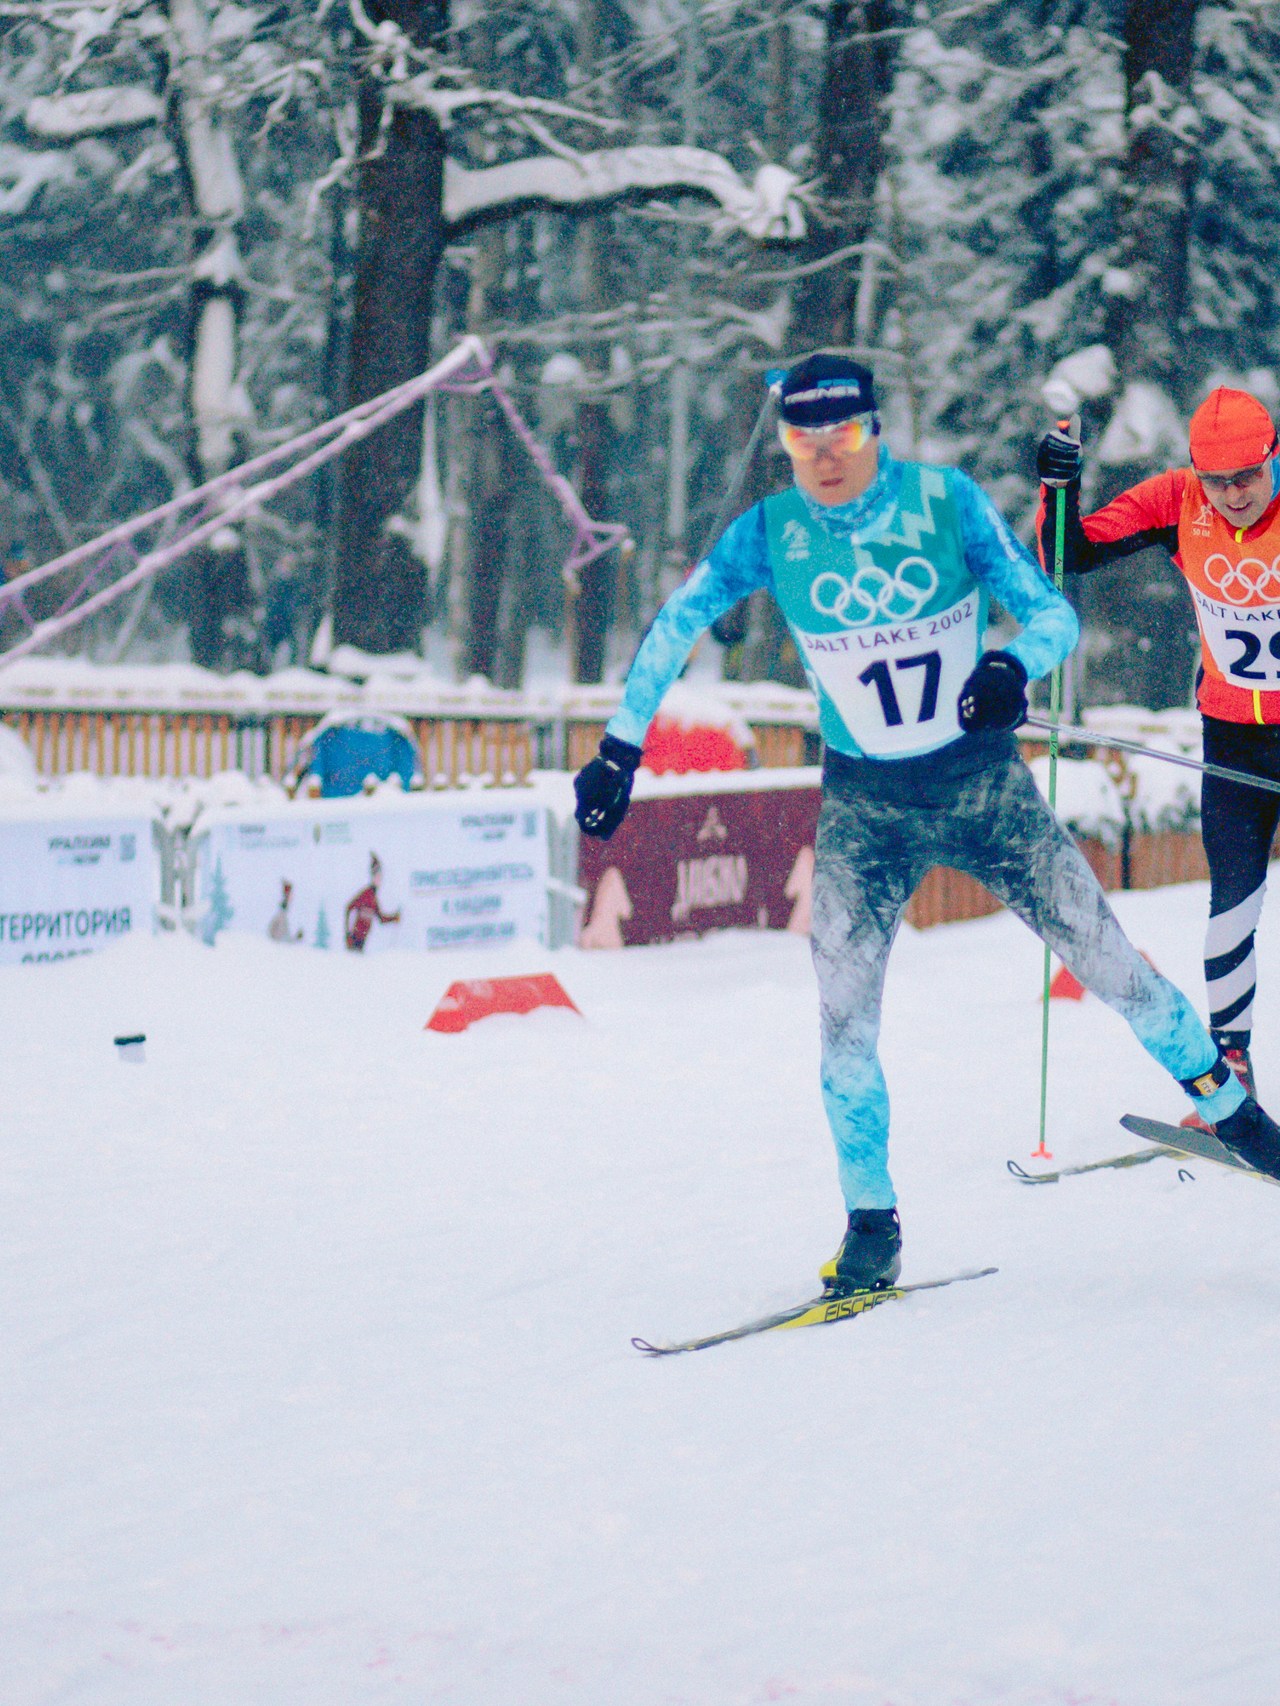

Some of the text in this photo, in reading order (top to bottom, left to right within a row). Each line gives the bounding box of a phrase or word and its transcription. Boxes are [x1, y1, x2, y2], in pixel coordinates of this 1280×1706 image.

[857, 626, 921, 649] LAKE
[926, 602, 973, 636] 2002
[1195, 592, 1228, 618] SALT
[857, 649, 942, 728] 17
[0, 906, 131, 941] ТЕРРИТОРИЯ
